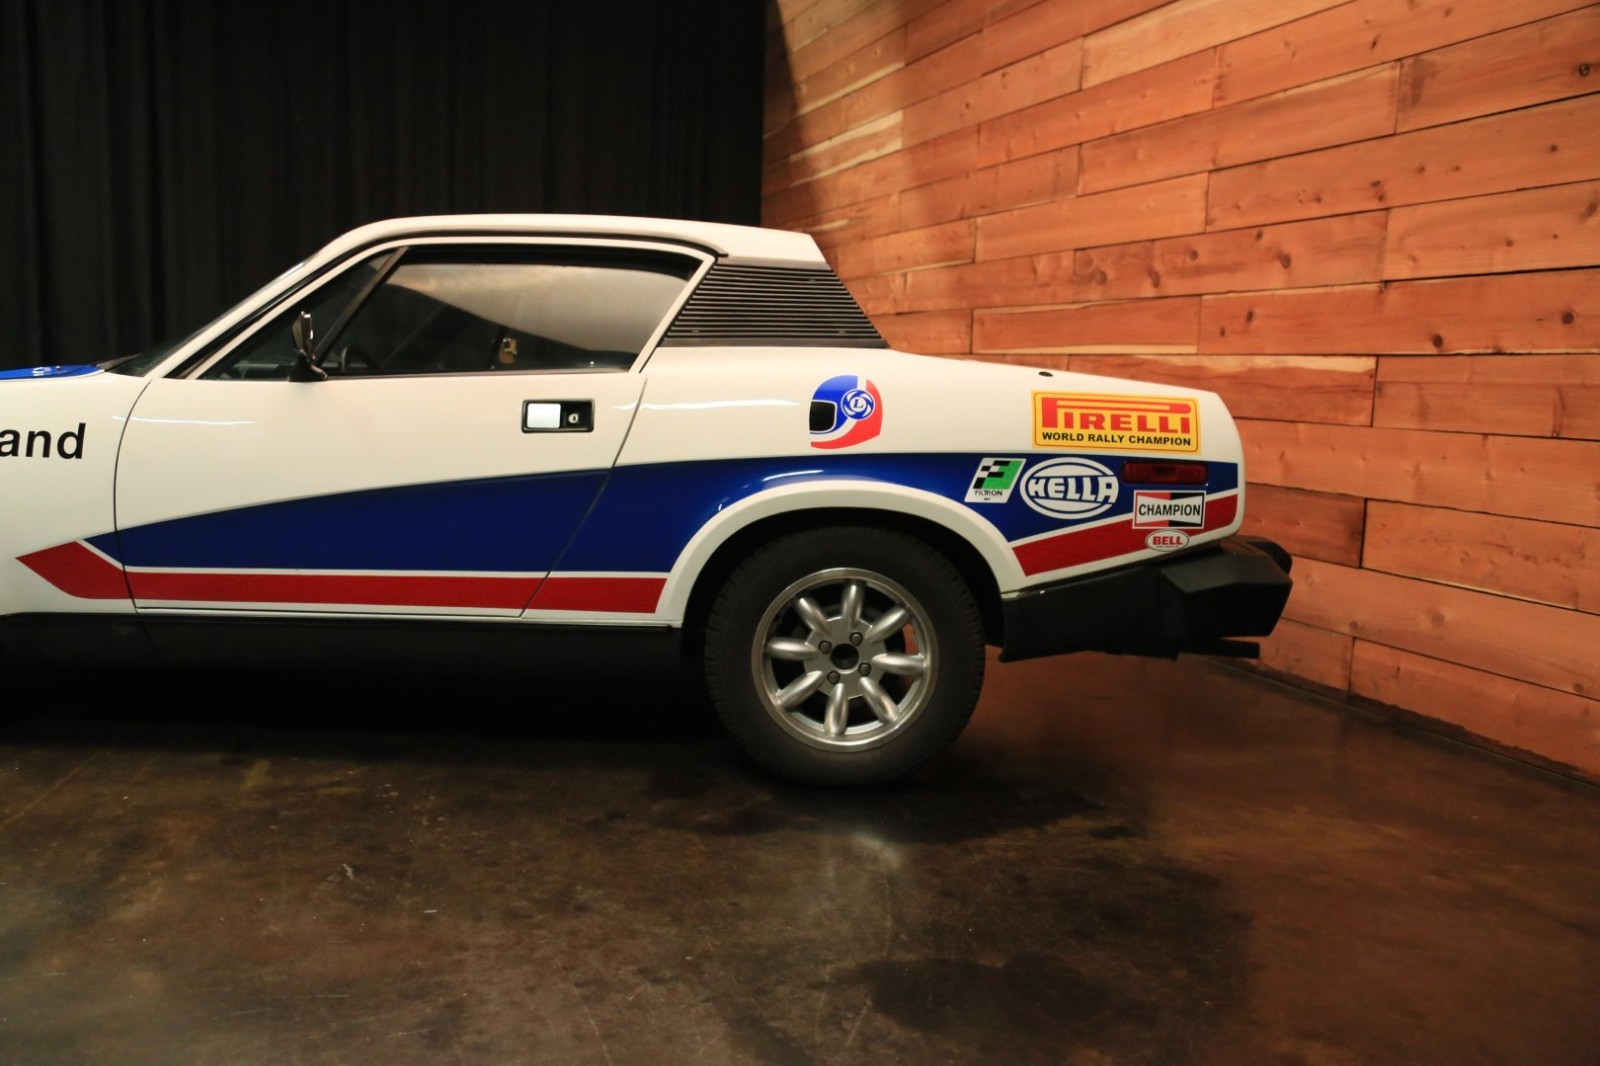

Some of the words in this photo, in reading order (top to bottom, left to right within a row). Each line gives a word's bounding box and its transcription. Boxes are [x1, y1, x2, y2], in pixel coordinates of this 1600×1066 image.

[1041, 397, 1192, 434] PIRELLI
[0, 422, 86, 459] and
[1042, 432, 1084, 442] WORLD
[1088, 434, 1125, 444] RALLY
[1128, 435, 1191, 446] CHAMPION
[1027, 476, 1119, 504] HELLA
[1138, 504, 1201, 516] CHAMPION
[1152, 536, 1183, 546] BELL
